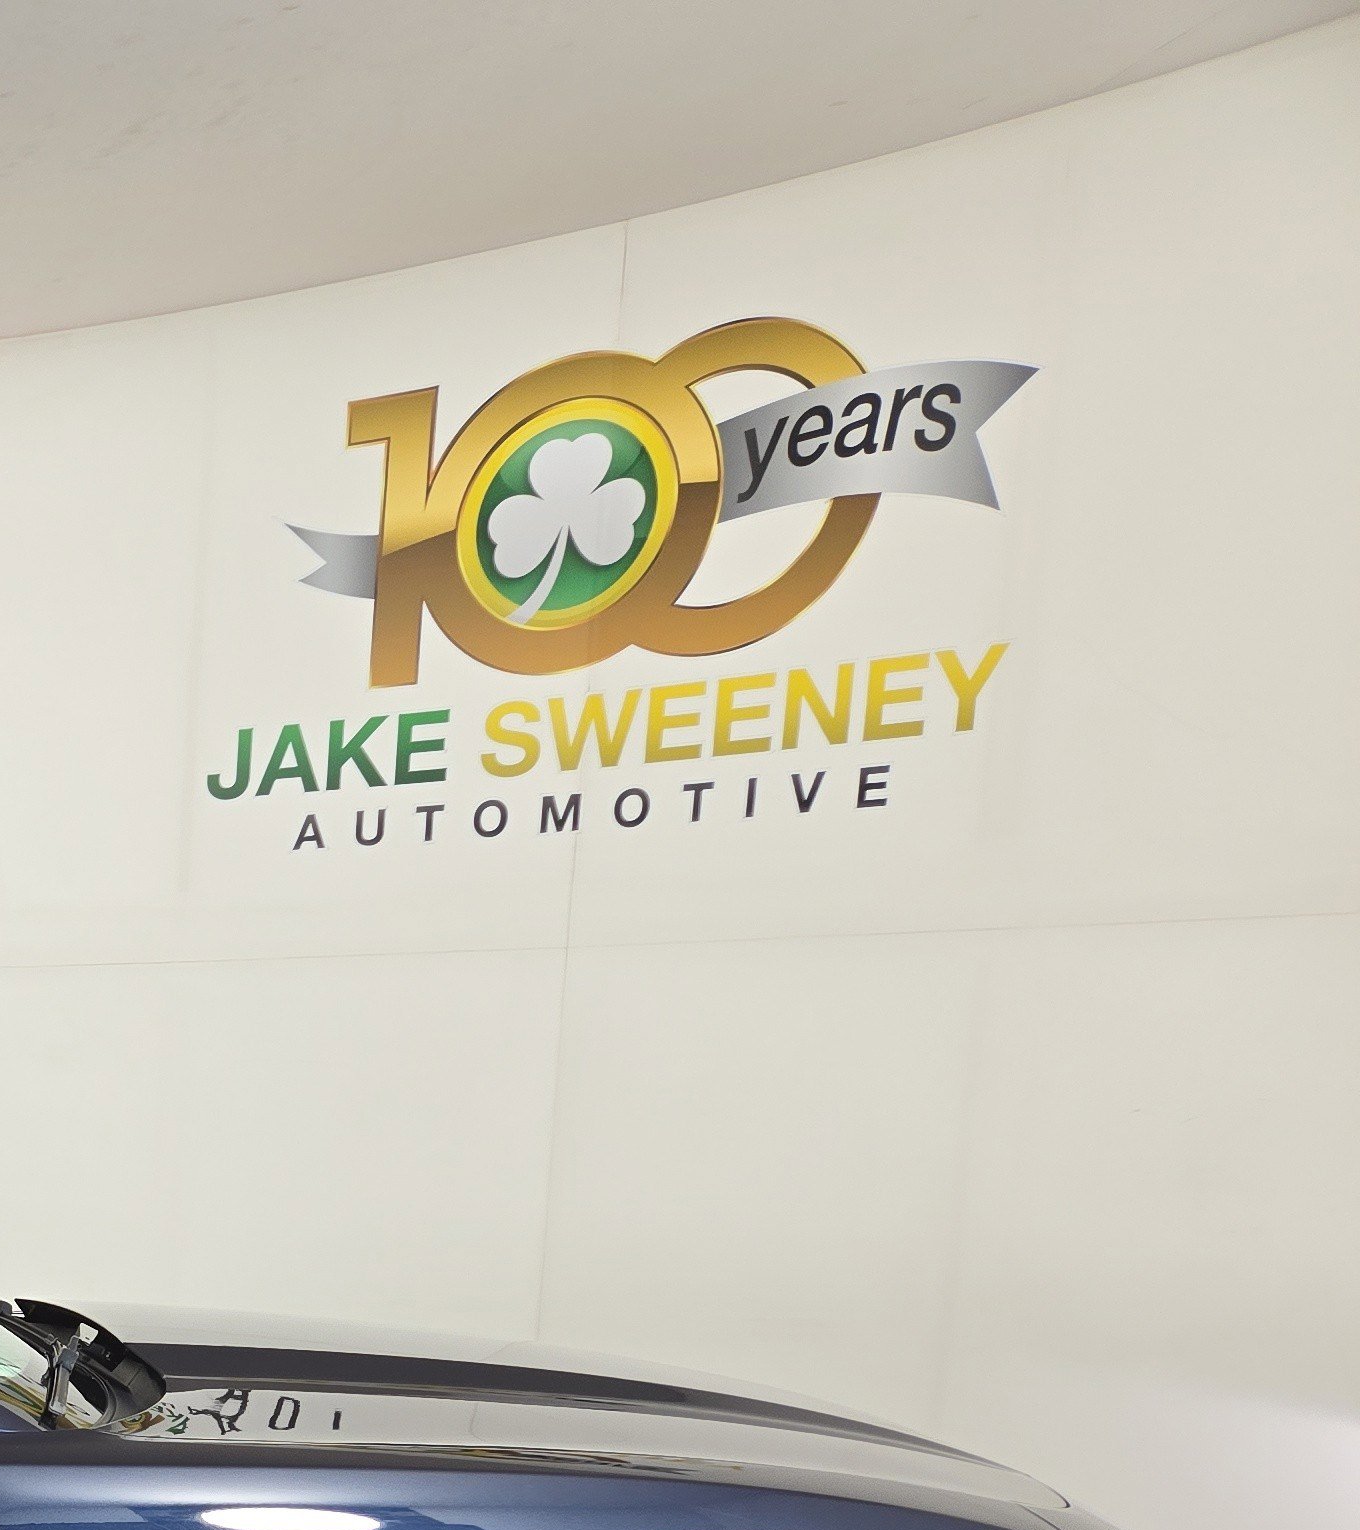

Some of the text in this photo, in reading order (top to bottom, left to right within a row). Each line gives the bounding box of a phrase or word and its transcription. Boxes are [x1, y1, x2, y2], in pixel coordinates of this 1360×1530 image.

[738, 382, 961, 503] years
[206, 642, 1011, 800] JAKE SWEENEY
[292, 765, 893, 850] AUTOMOTIVE
